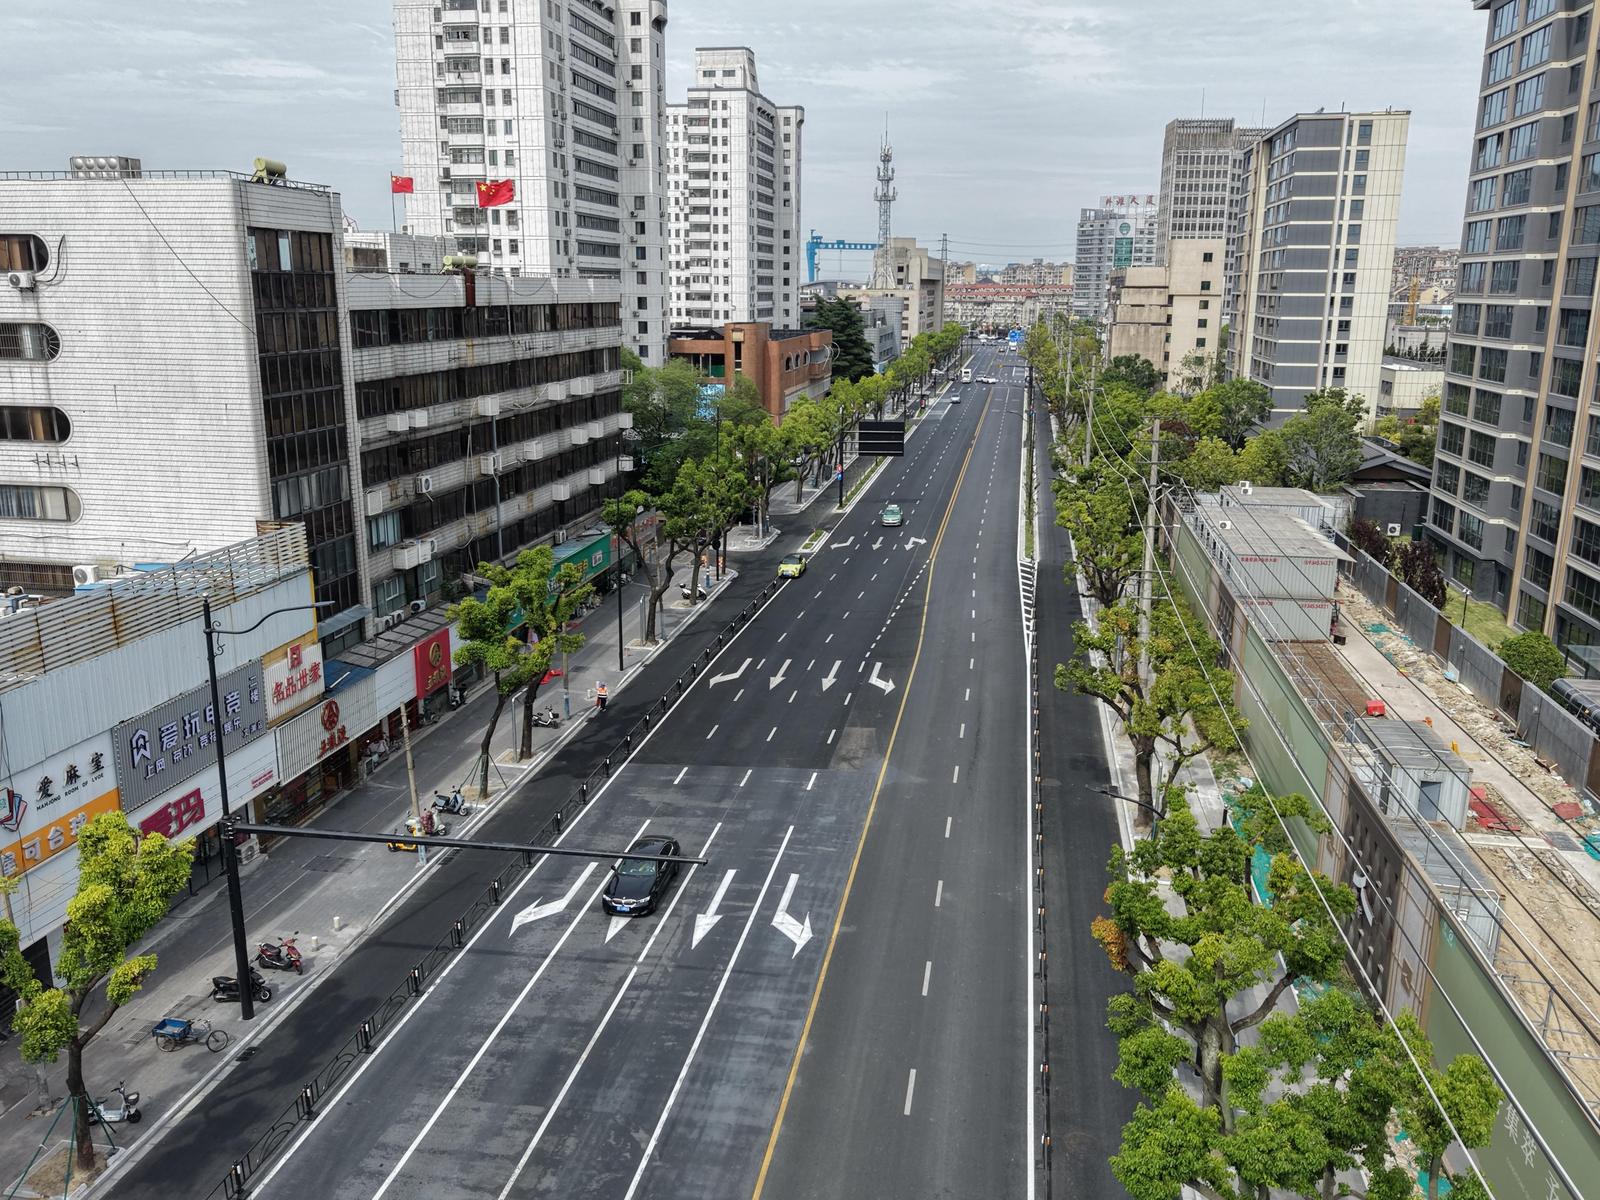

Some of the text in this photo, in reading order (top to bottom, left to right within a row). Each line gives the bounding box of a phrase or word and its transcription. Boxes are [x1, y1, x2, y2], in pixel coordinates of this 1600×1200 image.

[273, 661, 322, 704] 名品世家
[159, 689, 241, 752] 爱玩电竞
[145, 757, 166, 780] 上网
[222, 716, 241, 737] 娱乐
[36, 794, 62, 812] MAHJONG
[65, 786, 79, 797] ROOM
[82, 780, 89, 789] OF
[37, 751, 105, 802] 爱麻室
